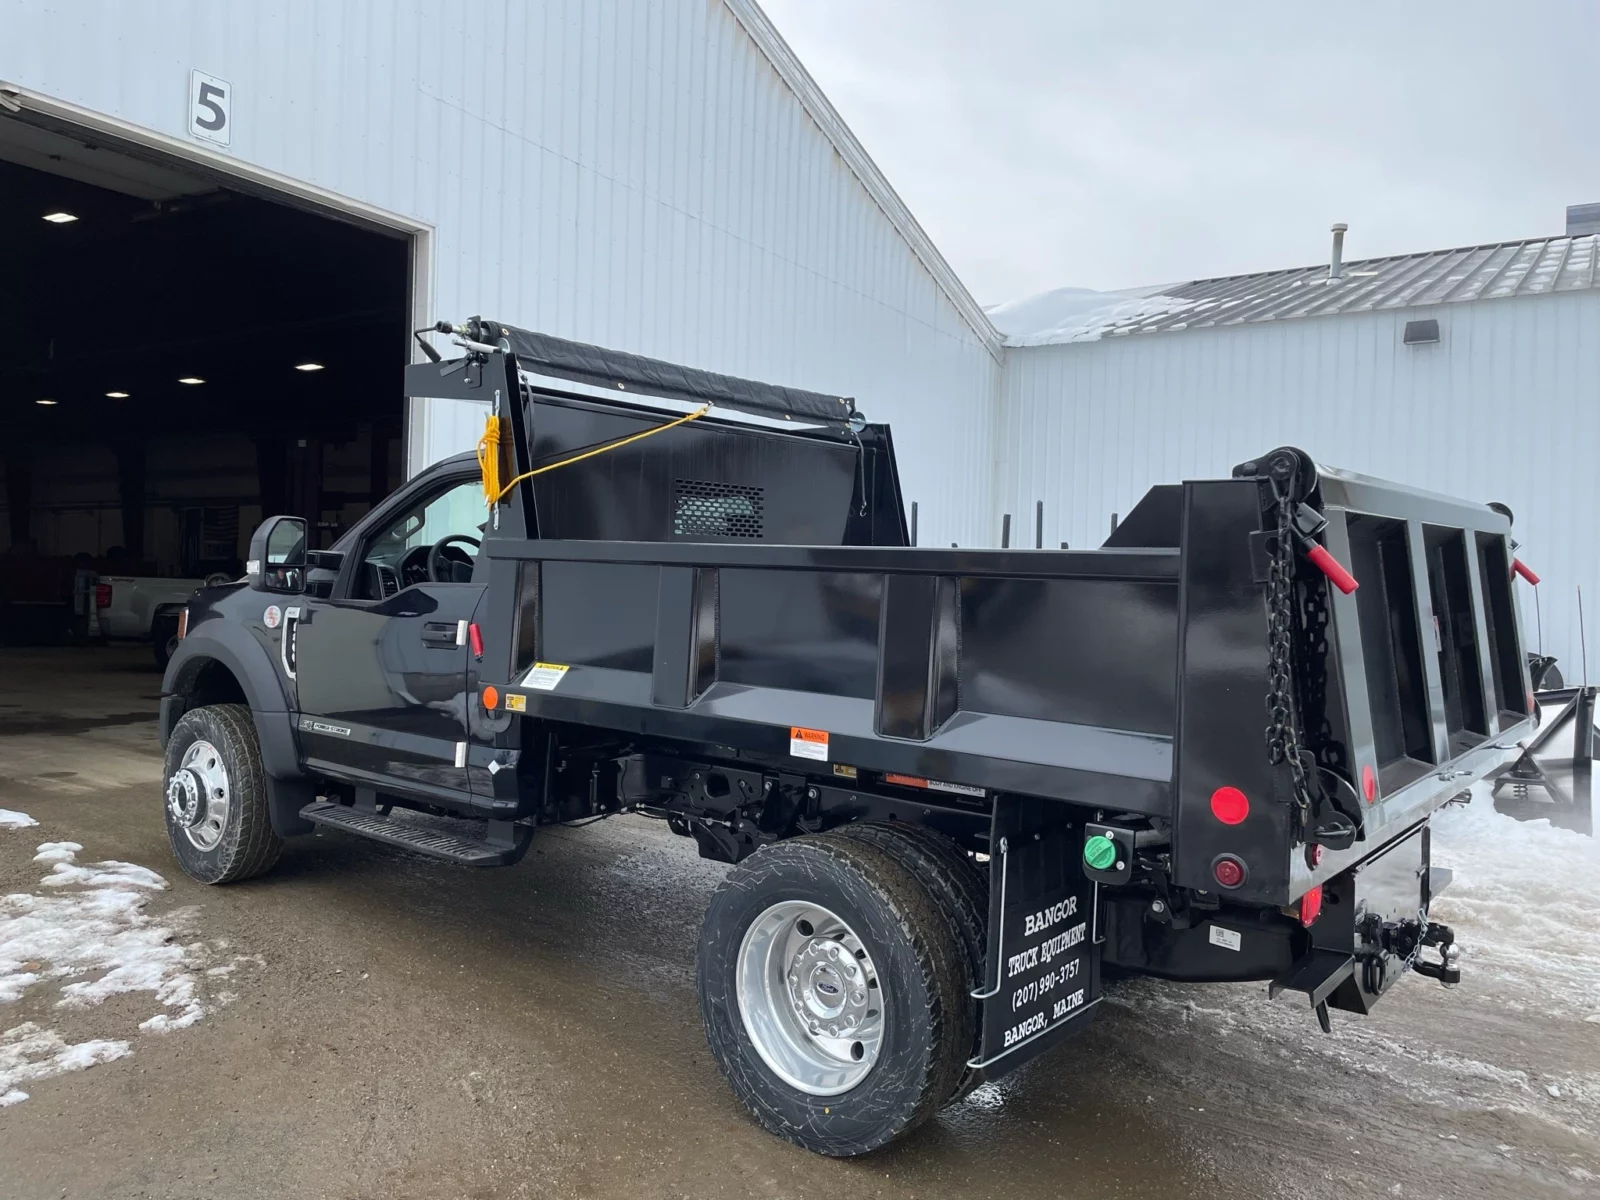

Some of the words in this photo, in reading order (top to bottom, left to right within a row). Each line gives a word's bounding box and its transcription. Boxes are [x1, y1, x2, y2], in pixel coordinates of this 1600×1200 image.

[196, 81, 226, 131] 5
[804, 731, 825, 742] WARNING
[1024, 895, 1078, 936] BANGOR
[1008, 948, 1039, 977] TRUCK
[1040, 922, 1086, 963] EQUIPMENT
[1003, 1011, 1048, 1047] BANGOR,
[1052, 988, 1084, 1019] MAINE
